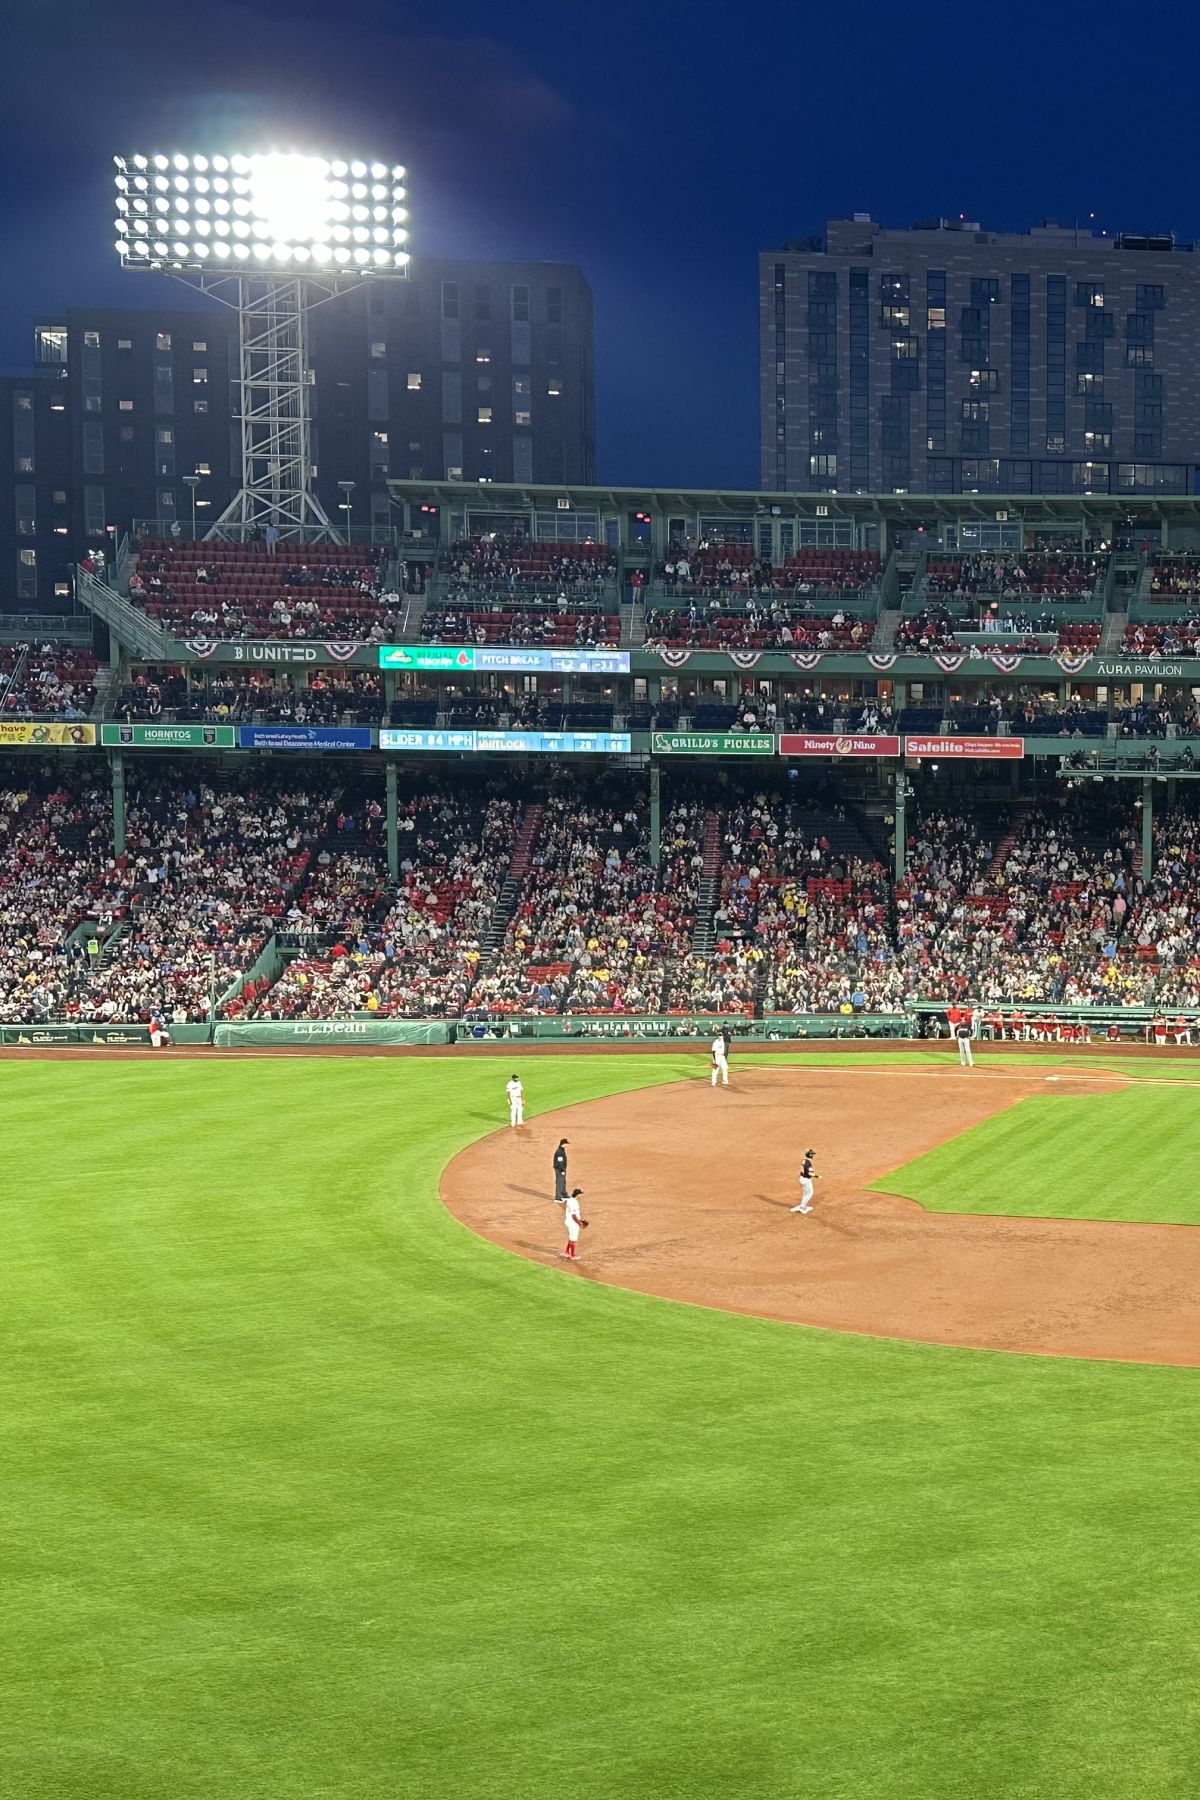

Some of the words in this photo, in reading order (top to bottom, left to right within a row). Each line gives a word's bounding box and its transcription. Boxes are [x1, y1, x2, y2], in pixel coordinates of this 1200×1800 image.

[1135, 665, 1182, 675] PAVILION
[145, 730, 191, 738] HORNITOS
[382, 734, 422, 746] SLIDER
[672, 738, 718, 748] GRILLO'S
[724, 739, 770, 749] PICKLES
[804, 740, 834, 750] Ninety
[854, 741, 875, 750] Nine
[908, 742, 963, 752] Safelite
